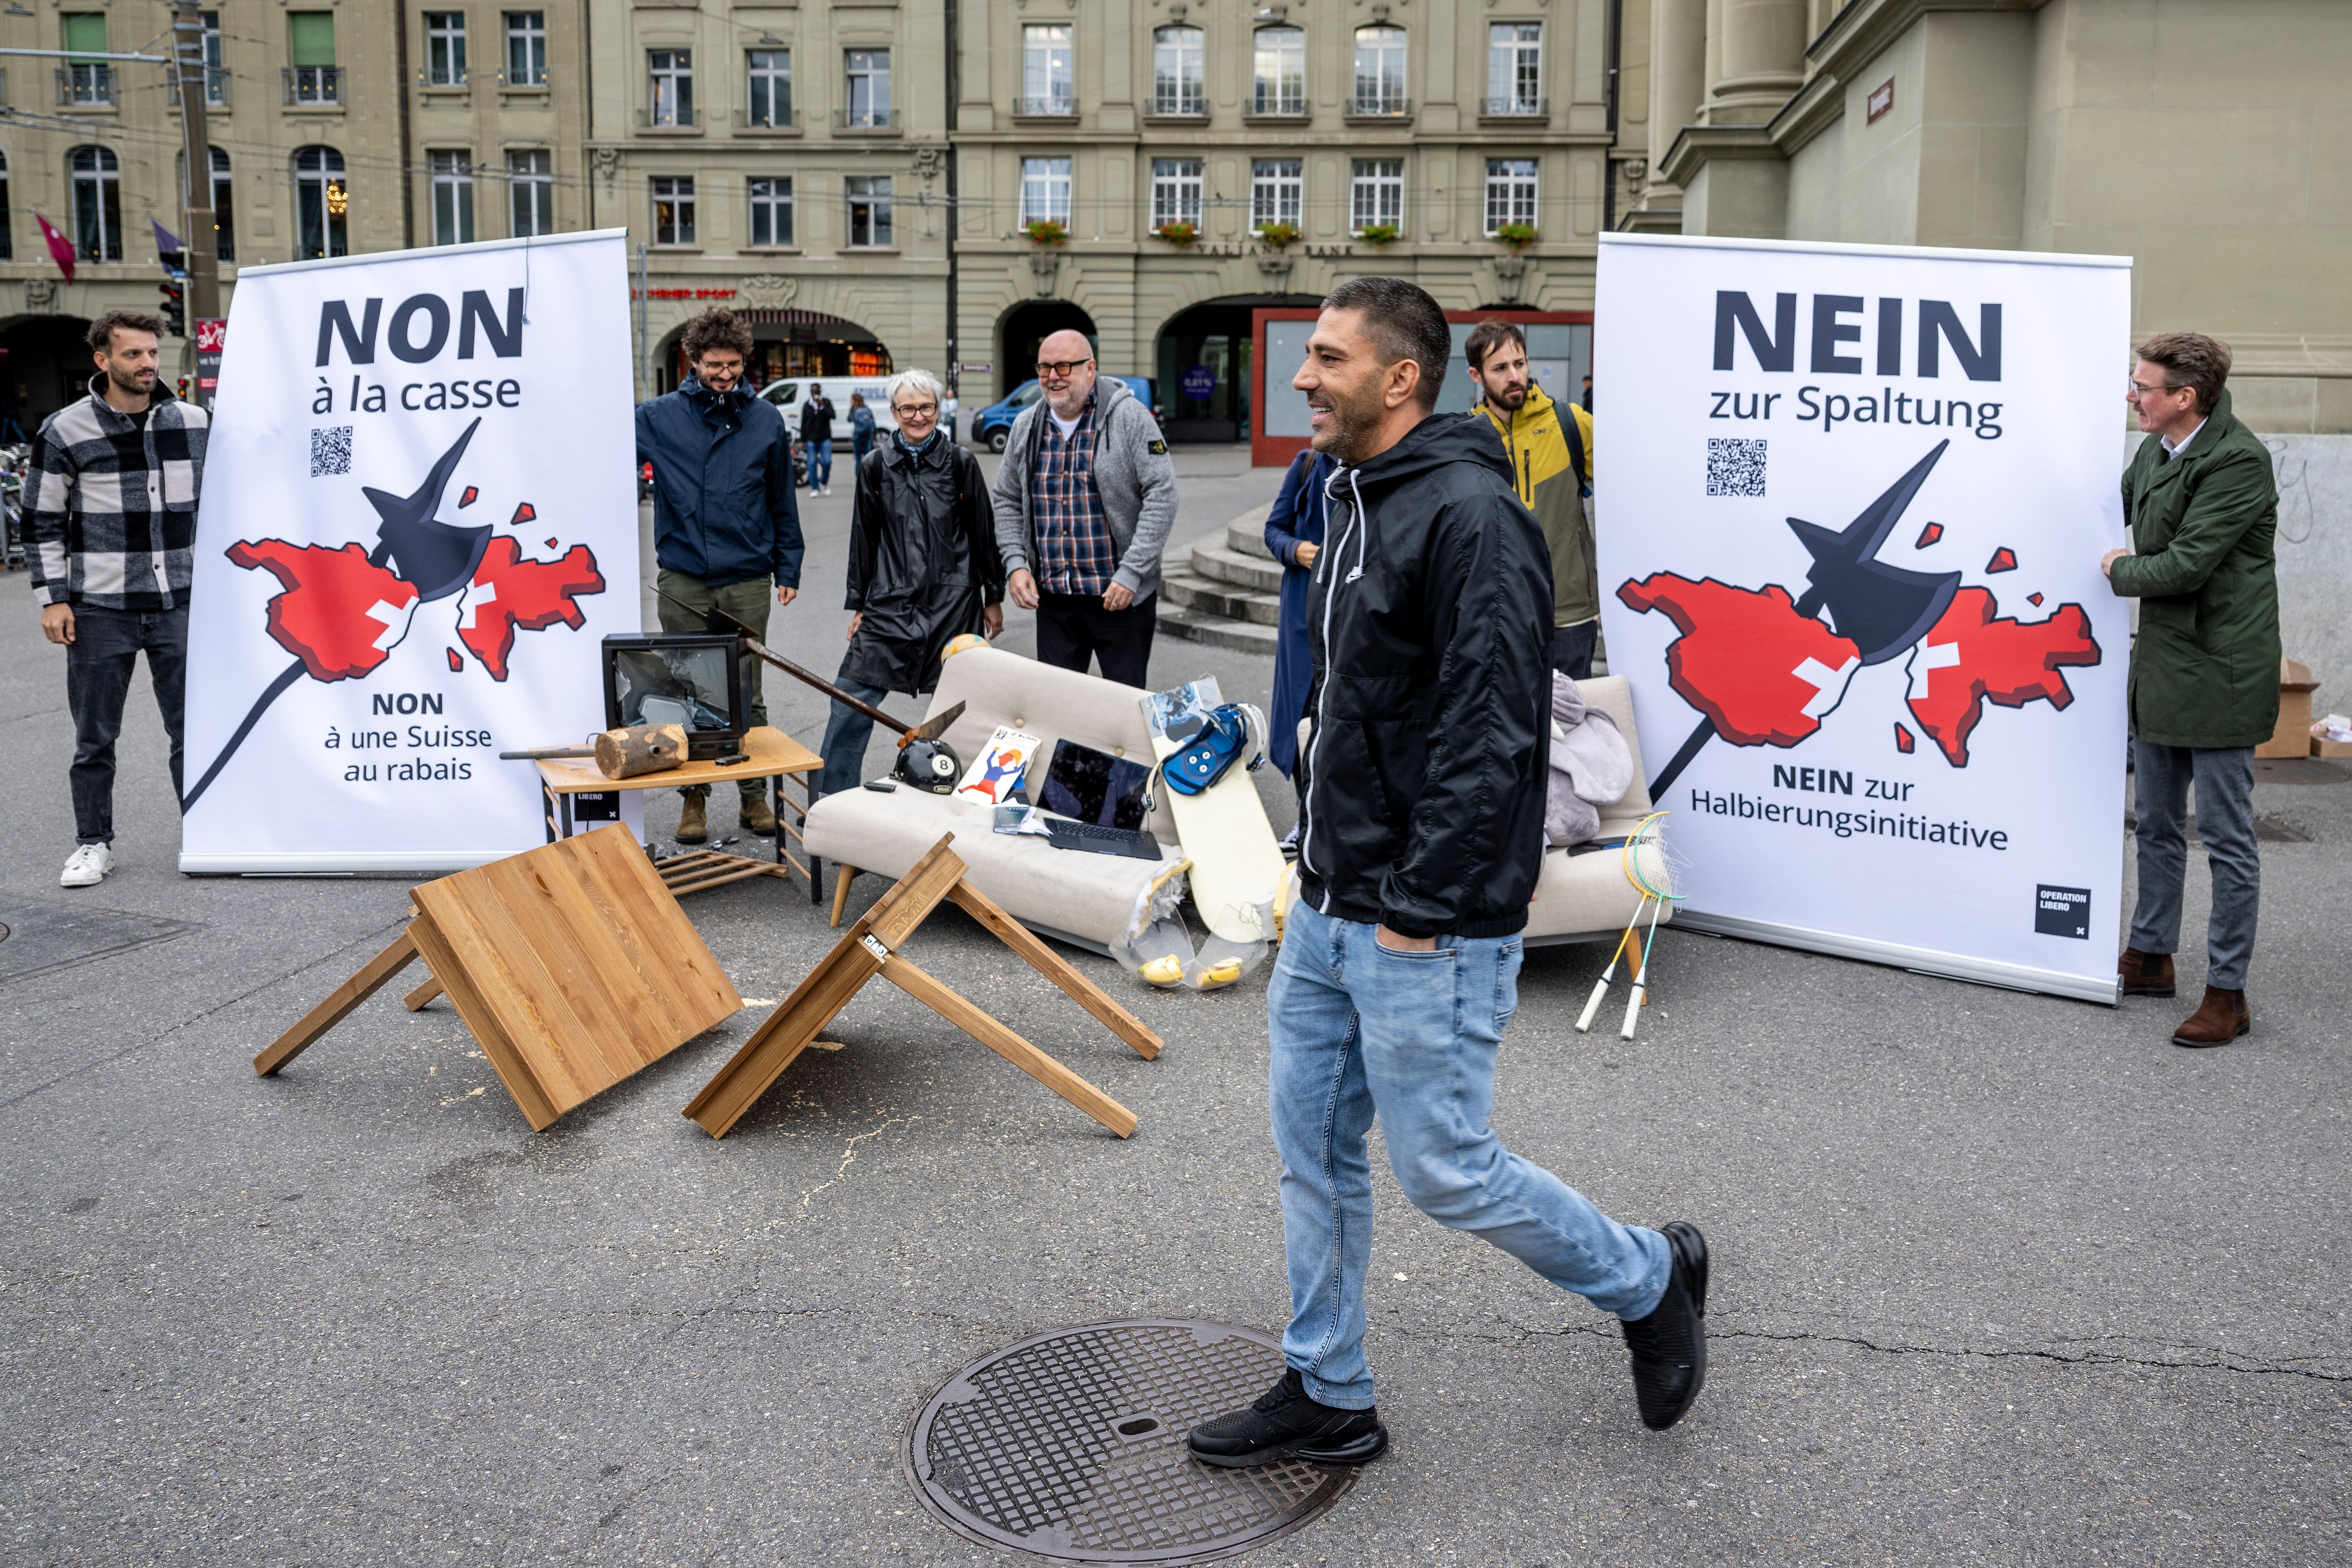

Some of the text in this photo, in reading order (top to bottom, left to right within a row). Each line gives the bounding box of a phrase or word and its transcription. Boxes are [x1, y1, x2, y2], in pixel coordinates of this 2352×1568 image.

[1305, 245, 1354, 256] BANK
[696, 288, 737, 299] SPORT
[315, 287, 524, 368] NON
[1713, 290, 2002, 382] NEIN
[312, 375, 521, 414] à la casse
[1710, 386, 2003, 440] zur Spaltung
[373, 693, 443, 715] NON
[325, 725, 492, 749] à une Suisse
[345, 758, 472, 781] au rabais
[940, 760, 948, 769] 8
[1774, 764, 1915, 801] NEIN zur
[1691, 789, 2009, 851] Halbierungsinitiative
[2040, 890, 2087, 903] OPERATION
[2040, 900, 2070, 912] LIBERO
[1165, 1498, 1245, 1526] NOTTARIS
